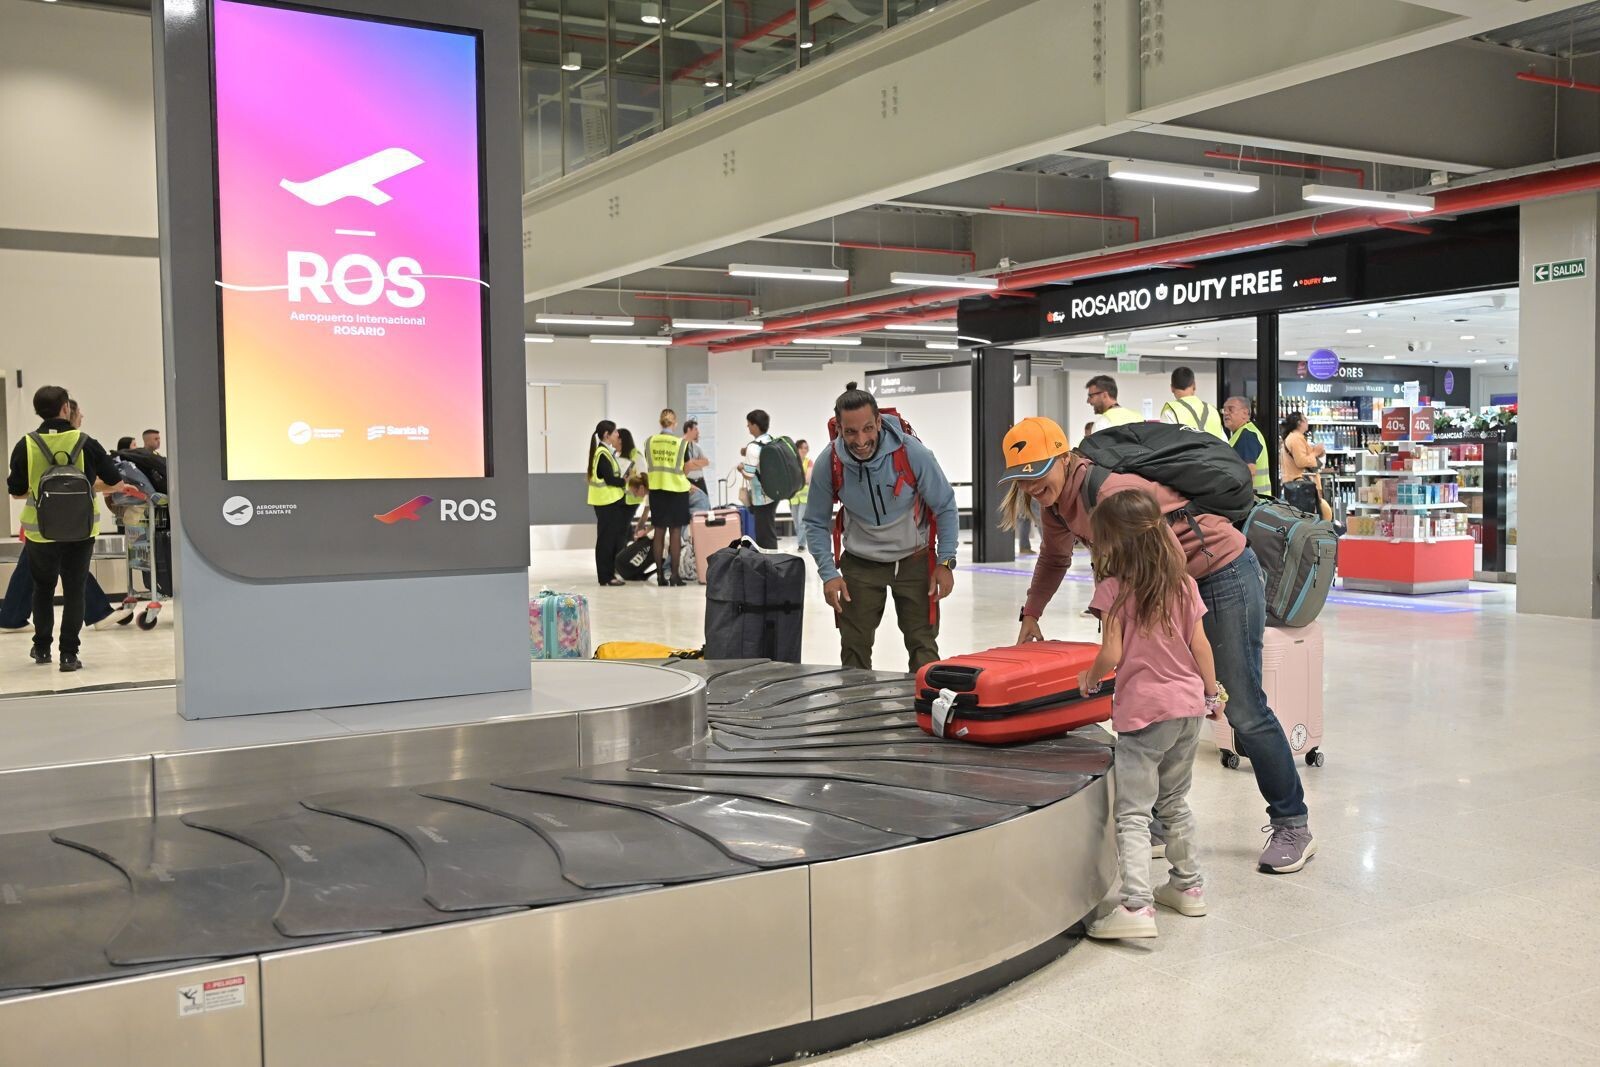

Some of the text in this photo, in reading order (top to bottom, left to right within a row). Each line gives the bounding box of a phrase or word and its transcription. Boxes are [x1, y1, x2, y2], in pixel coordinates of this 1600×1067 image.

[1553, 263, 1584, 277] SALIDA
[287, 251, 426, 308] ROS
[1071, 268, 1283, 319] ROSARIO DUTY FREE
[290, 311, 426, 326] Aeropuerto Internacional
[333, 326, 386, 337] ROSARIO
[1306, 383, 1333, 393] ABSOLUT
[1386, 420, 1406, 431] 40%
[1414, 420, 1431, 431] 40%
[1022, 464, 1034, 473] 4
[440, 499, 497, 521] ROS
